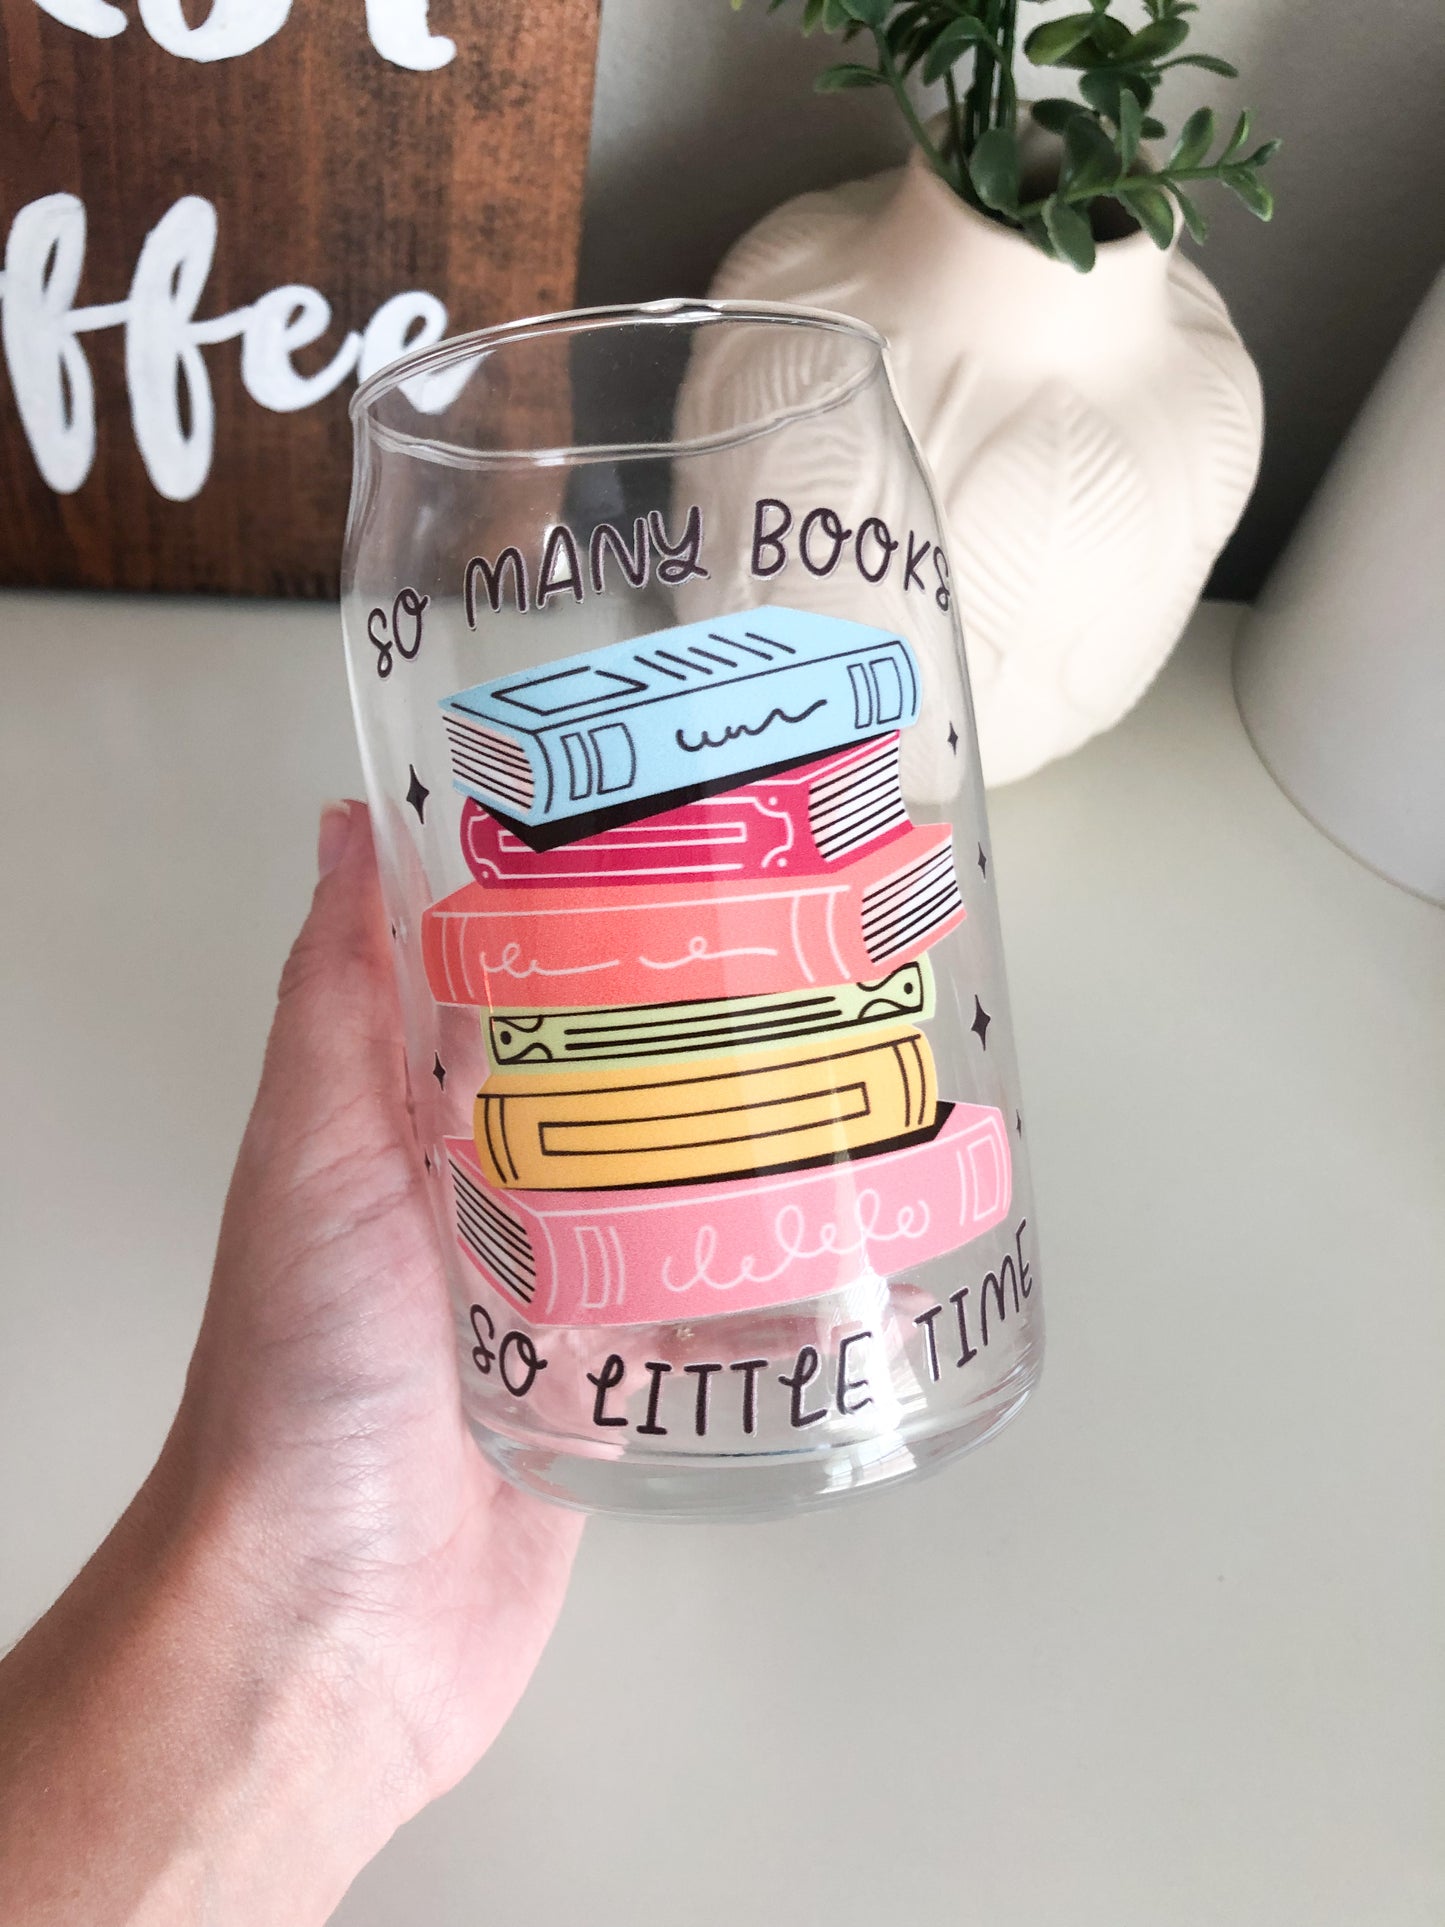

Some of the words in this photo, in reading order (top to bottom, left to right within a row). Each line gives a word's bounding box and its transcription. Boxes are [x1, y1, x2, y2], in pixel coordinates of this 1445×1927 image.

[0, 192, 496, 502] ffee
[367, 585, 431, 679] SO
[463, 505, 711, 630] MANY
[750, 498, 952, 614] BOOKS
[470, 1303, 549, 1398] SO
[587, 1330, 874, 1437] LITTLE
[913, 1217, 1035, 1383] TIME
